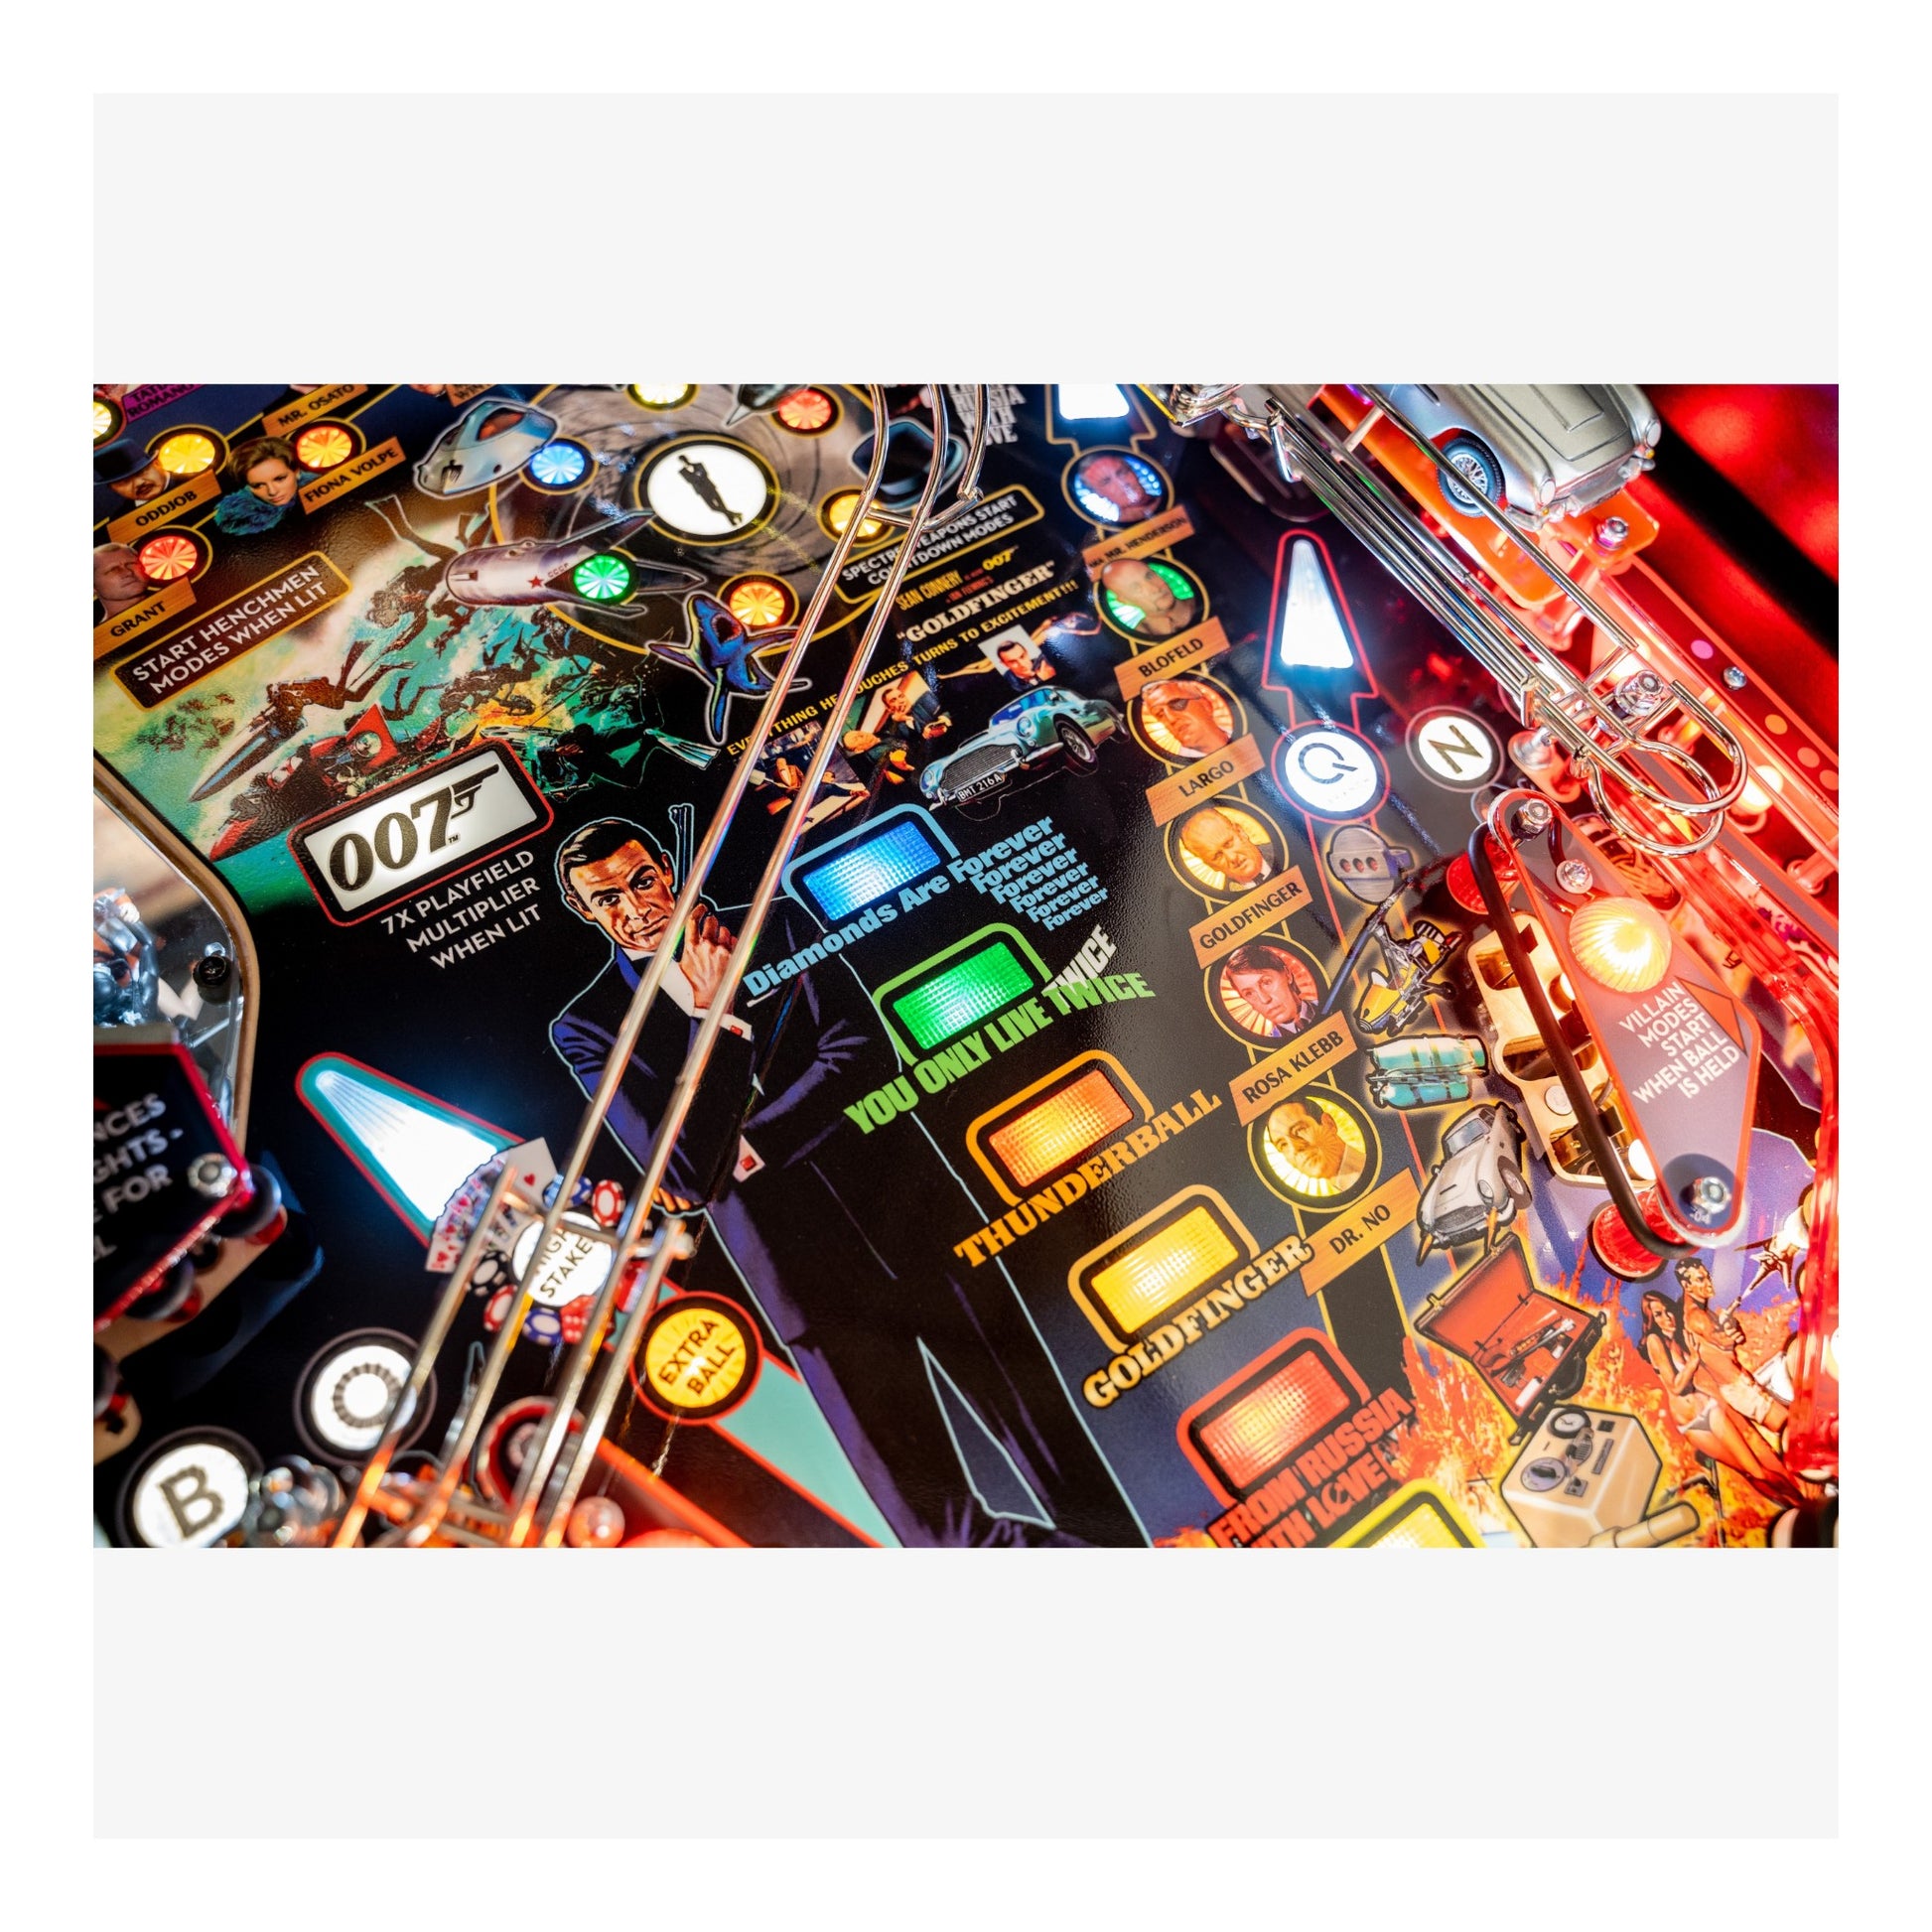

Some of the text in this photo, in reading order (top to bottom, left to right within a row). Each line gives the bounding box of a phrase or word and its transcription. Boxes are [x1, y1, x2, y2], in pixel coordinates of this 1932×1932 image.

[278, 384, 354, 427] MR. OSATO
[304, 448, 398, 503] FIONA VOLPE
[135, 489, 198, 528] ODDJOB
[842, 495, 1019, 581] SPECTR EAPONS START
[867, 512, 1016, 586] COTDOWN MODES
[982, 550, 1013, 571] 007
[110, 600, 167, 638] GRANT
[896, 589, 924, 611] SEAN
[919, 570, 963, 599] CONNERY
[132, 565, 321, 681] START HENCHMEN
[150, 580, 328, 694] MODES WHEN LIT
[819, 693, 838, 711] HE
[912, 637, 959, 666] TURNS
[958, 627, 980, 643] TO
[980, 580, 1080, 632] EXCITEMENT!!!
[1138, 637, 1204, 678] BLOFELD
[958, 772, 1003, 799] BMT 216A
[1178, 759, 1235, 798] LARGO
[330, 786, 454, 892] 007
[969, 832, 1069, 895] Forever
[381, 850, 535, 935] 7X PLAYFIELD
[743, 815, 1056, 999] Diamonds Are Forever
[991, 847, 1079, 905] Forever
[1010, 861, 1090, 914] Forever
[1026, 874, 1100, 924] Forever
[405, 877, 541, 953] MULTIPLIER
[430, 903, 542, 970] WHEN LIT
[1041, 887, 1109, 932] Forever
[1198, 881, 1304, 950] GOLDFINGER
[1618, 980, 1688, 1034] VILLAIN
[1636, 997, 1700, 1049] MODES
[1660, 1013, 1712, 1057] START
[843, 972, 1157, 1135] YOU ONLY LIVE TWICE
[1241, 1030, 1344, 1104] ROSA KLEBB
[1631, 1032, 1728, 1104] WHEN BALL
[1677, 1044, 1740, 1099] IS HELD
[101, 1164, 174, 1214] FOR
[953, 1088, 1223, 1268] THUNDERBALL
[1328, 1203, 1392, 1255] DR. NO
[658, 1318, 720, 1386] EXTRA
[1081, 1233, 1315, 1409] GOLDFINGER
[685, 1342, 737, 1396] BALL
[1206, 1387, 1414, 1547] FROM RUSSIA
[1307, 1451, 1388, 1529] LOVE
[156, 1463, 225, 1538] B
